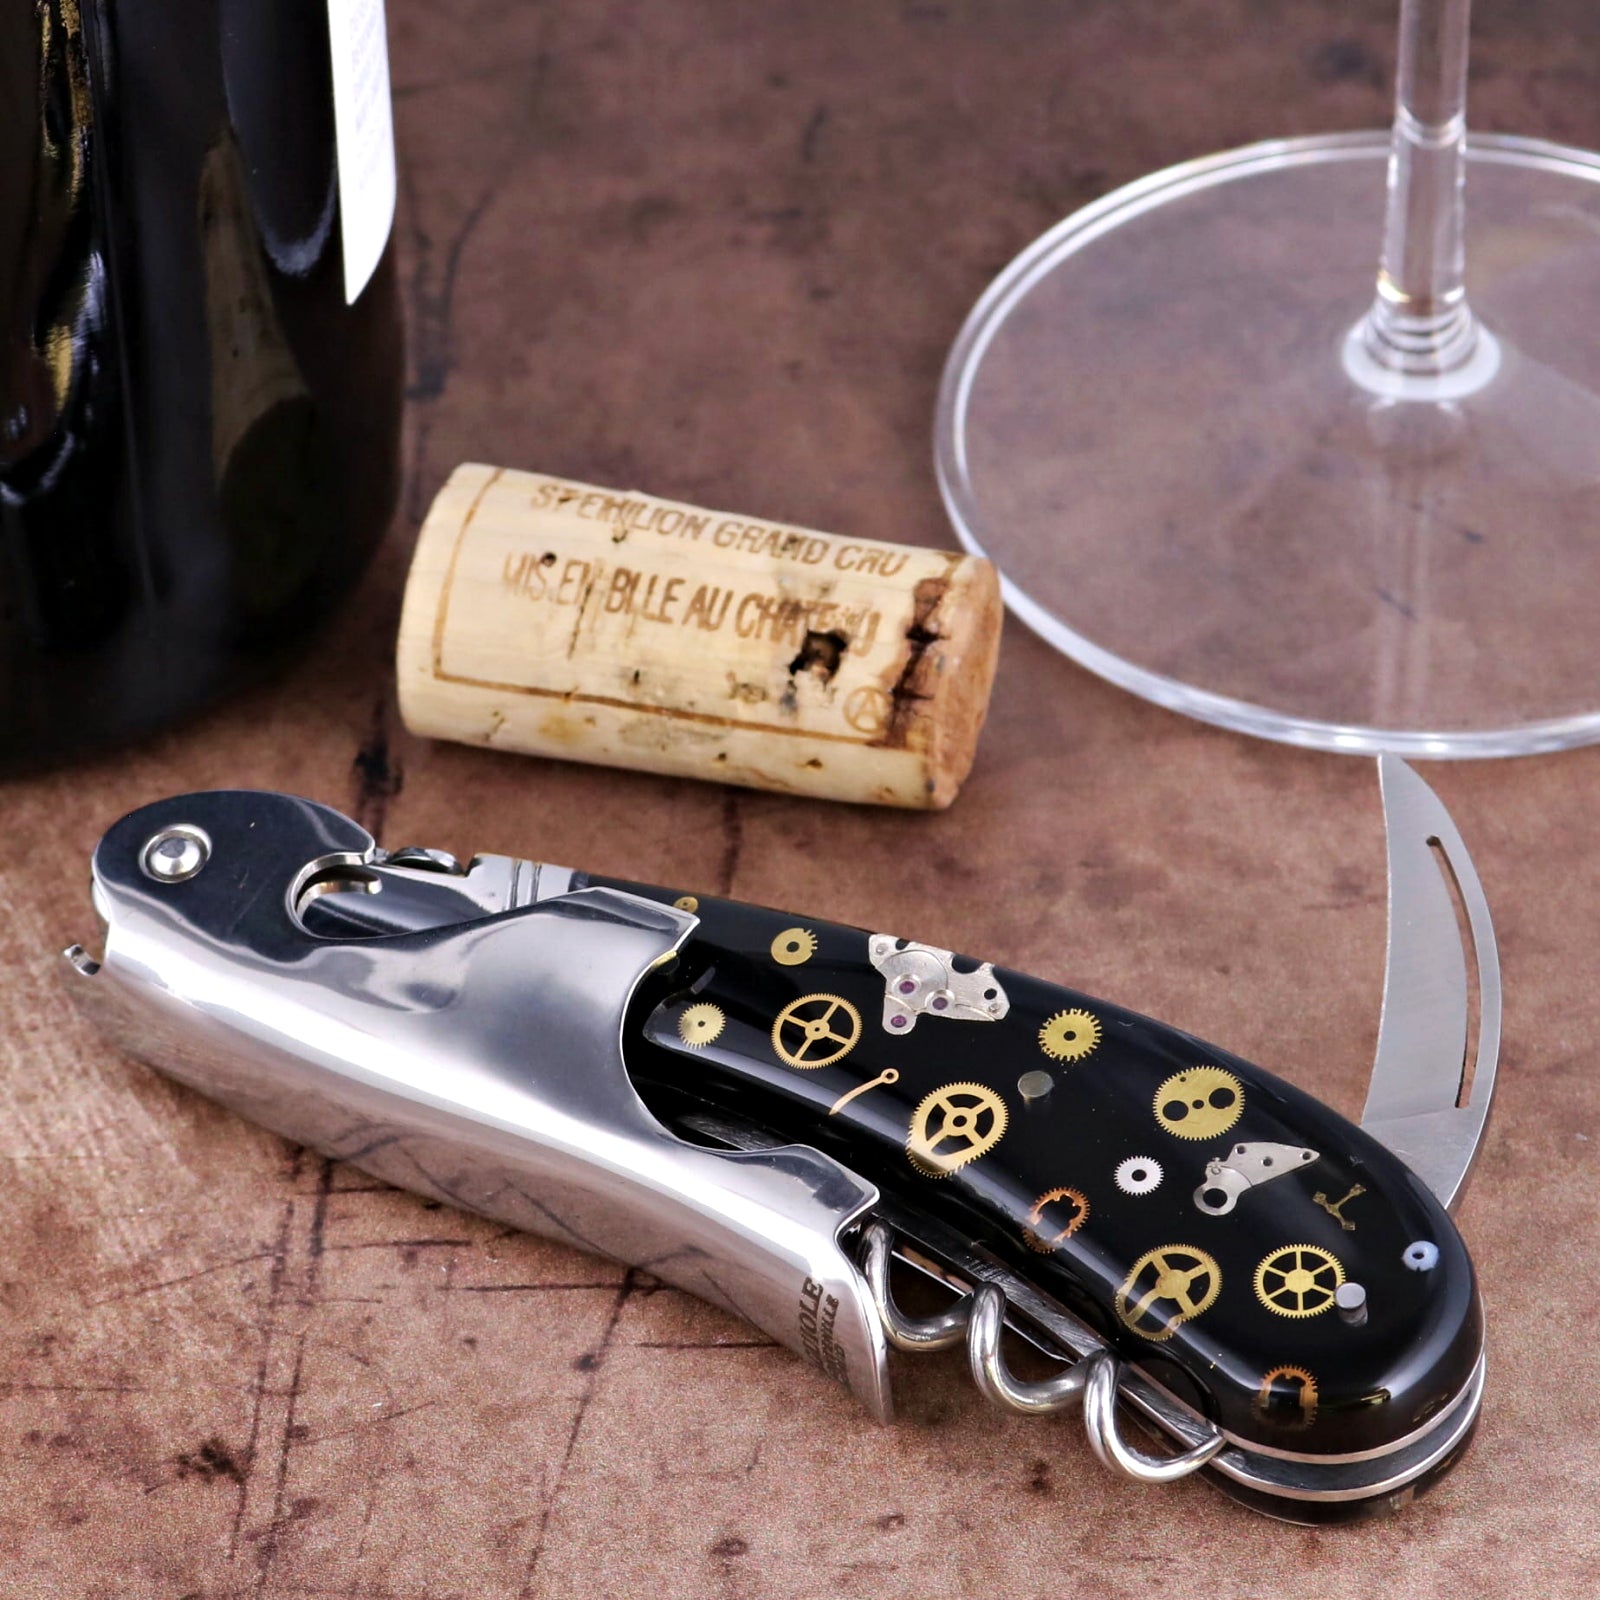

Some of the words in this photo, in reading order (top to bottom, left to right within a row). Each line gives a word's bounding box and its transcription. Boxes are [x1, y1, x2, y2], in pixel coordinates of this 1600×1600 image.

[712, 520, 830, 565] GRAND
[833, 545, 910, 577] CRU
[681, 584, 735, 632] AU
